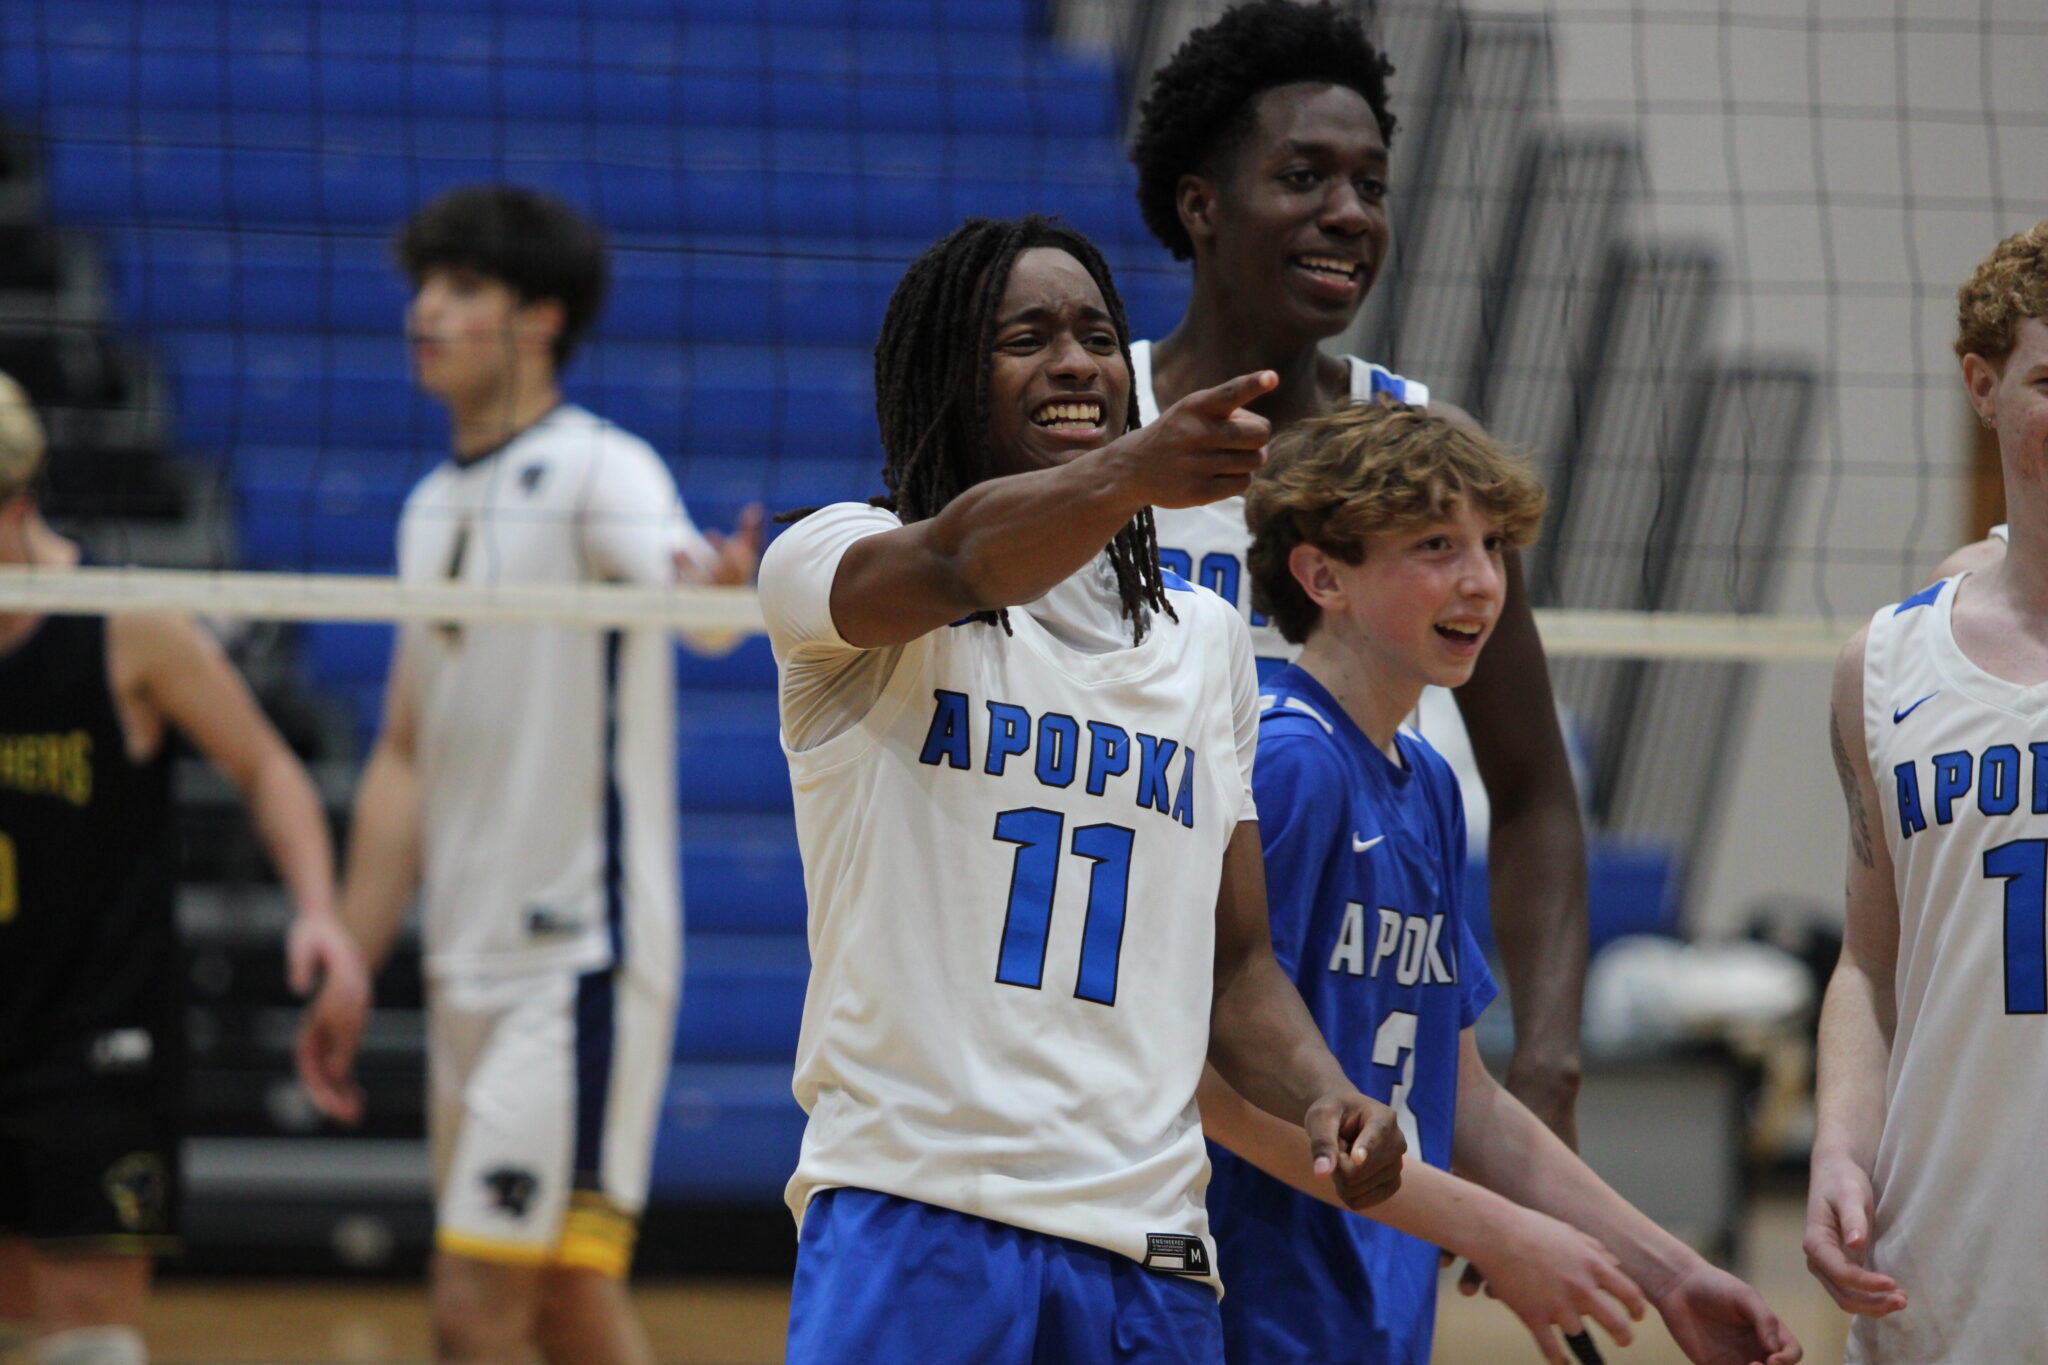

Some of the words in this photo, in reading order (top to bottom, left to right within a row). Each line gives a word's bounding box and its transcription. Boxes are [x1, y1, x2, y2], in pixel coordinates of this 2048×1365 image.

[919, 688, 1195, 829] APOPKA
[993, 806, 1136, 1007] 11
[1190, 1247, 1201, 1263] M
